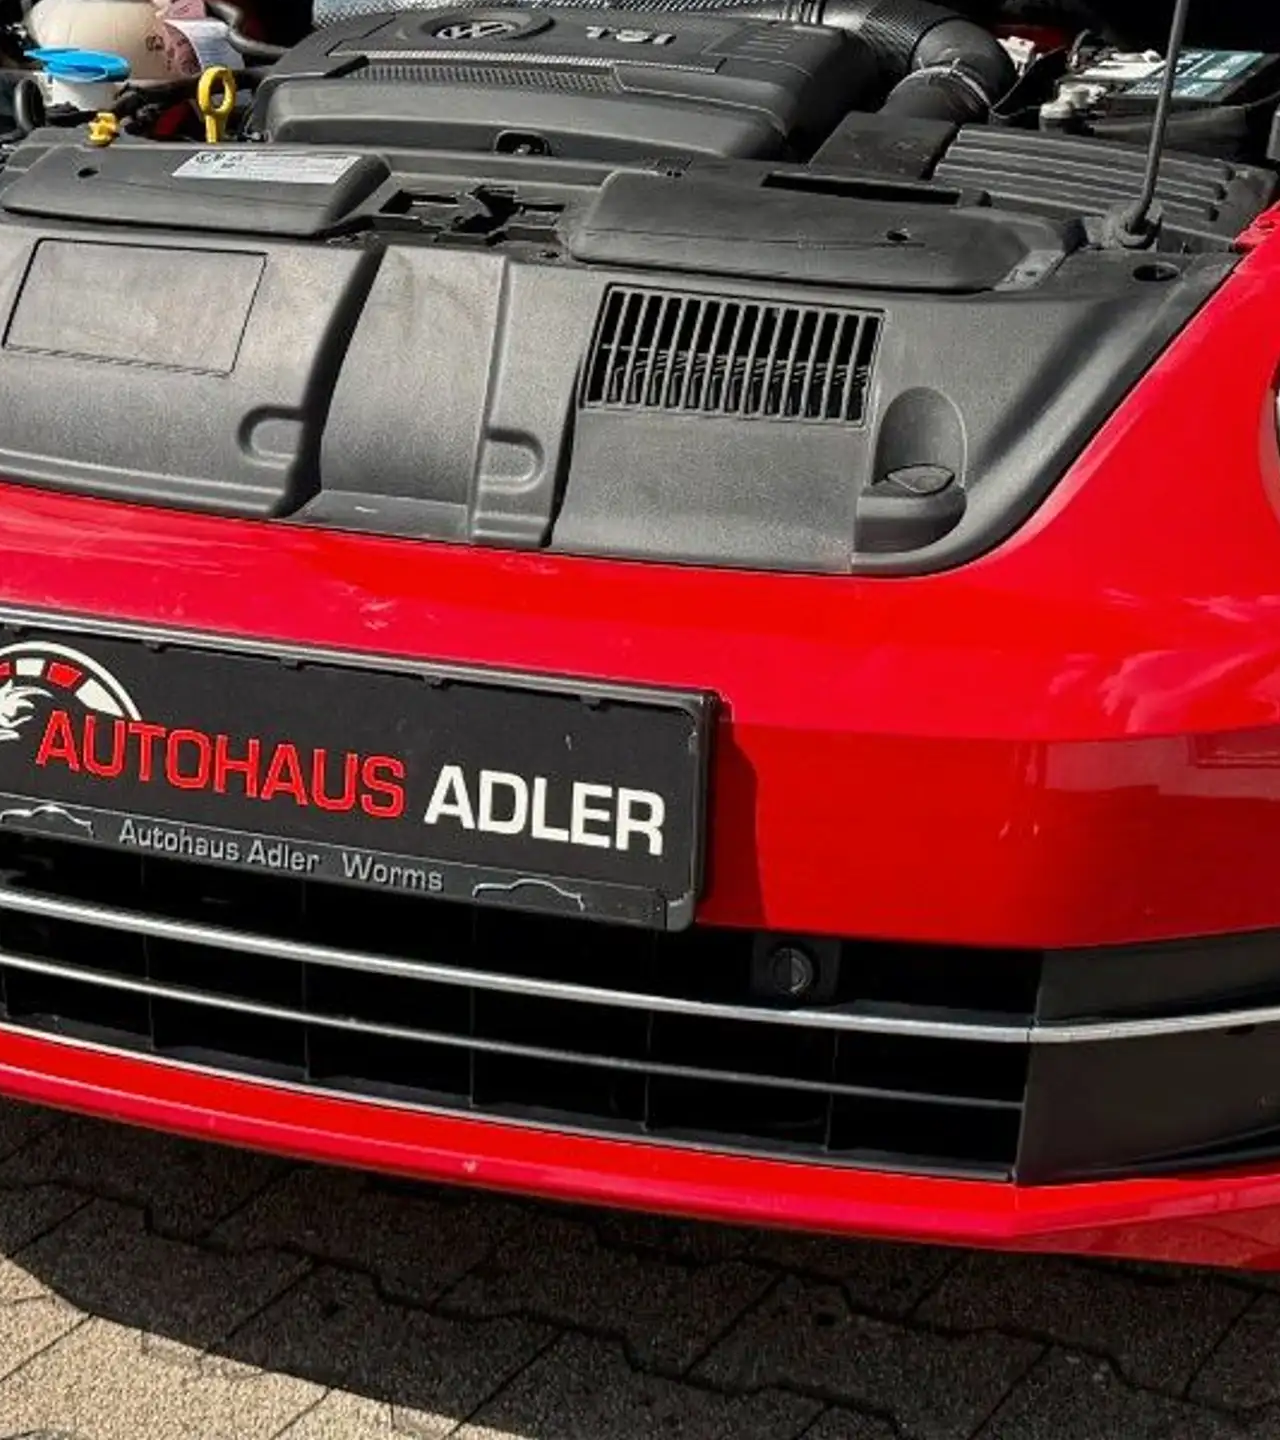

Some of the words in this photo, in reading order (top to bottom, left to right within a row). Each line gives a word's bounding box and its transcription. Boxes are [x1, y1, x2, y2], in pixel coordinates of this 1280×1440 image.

[35, 709, 409, 819] AUTOHAUS
[422, 762, 668, 857] ADLER
[119, 818, 240, 862] Autohaus
[246, 839, 320, 873] Adler
[342, 852, 444, 892] Worms
